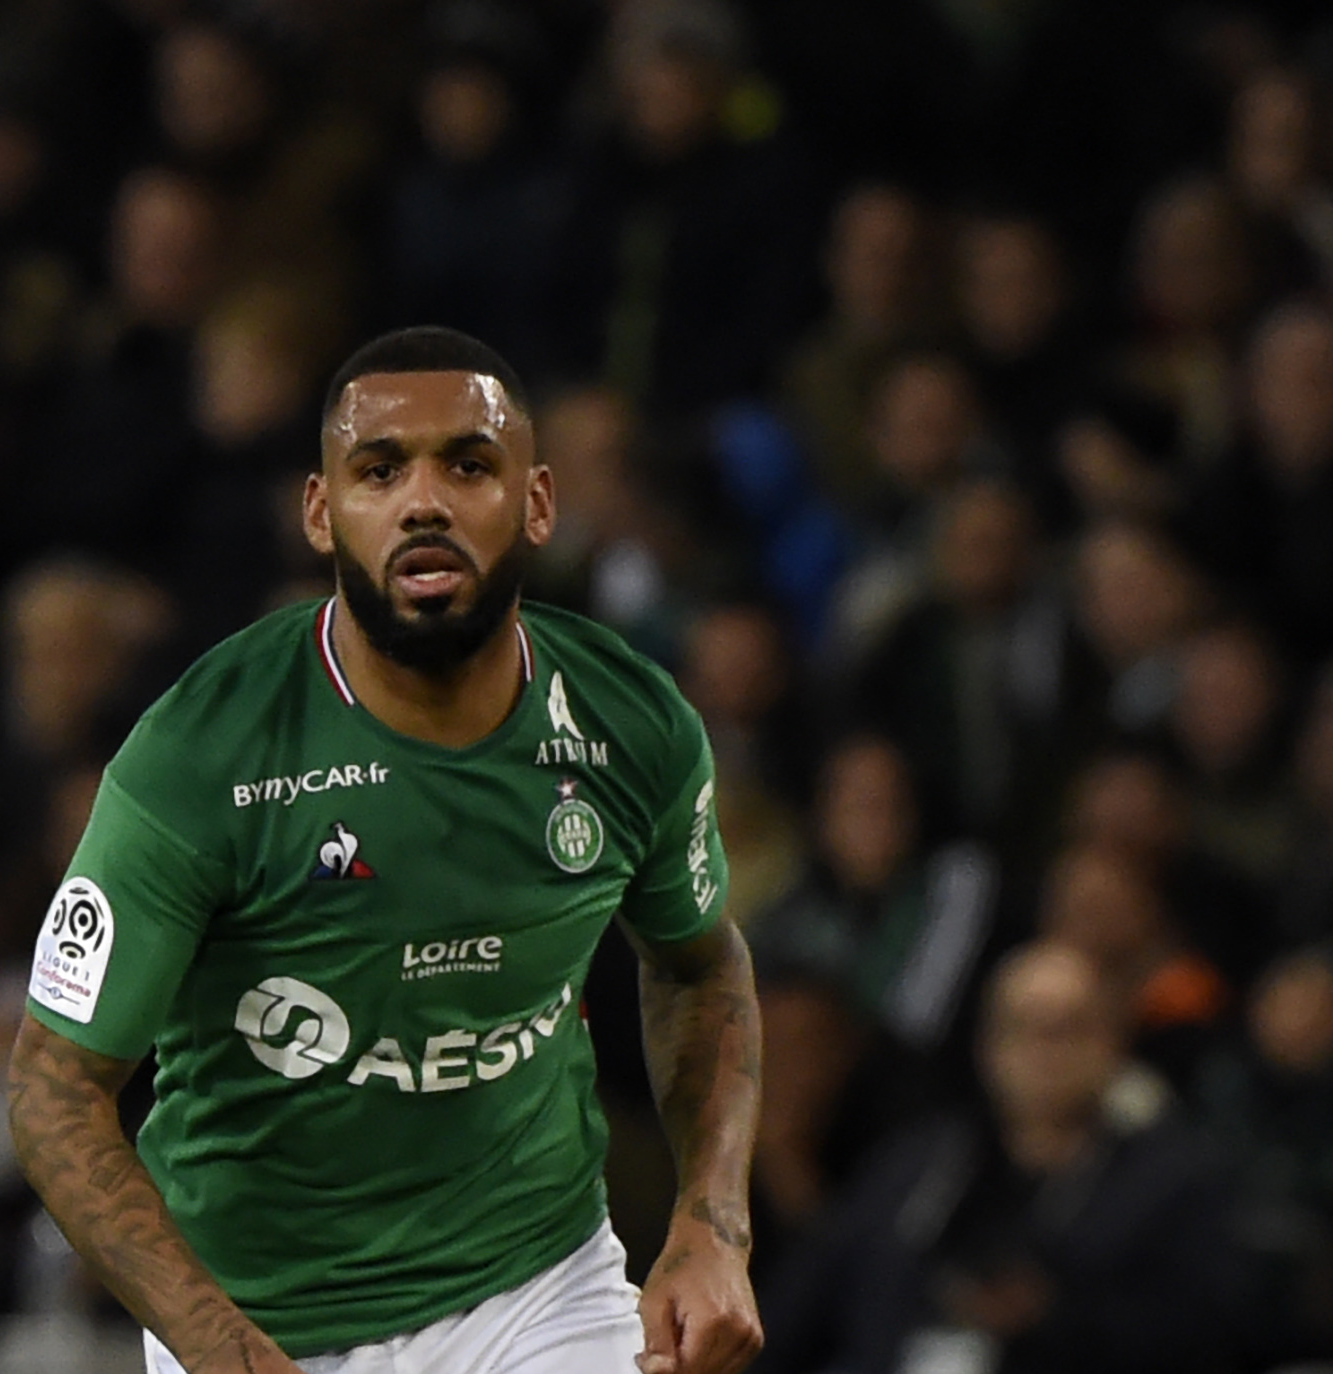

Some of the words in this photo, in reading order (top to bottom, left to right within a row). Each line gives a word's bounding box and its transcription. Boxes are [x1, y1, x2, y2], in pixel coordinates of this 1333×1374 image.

[535, 737, 609, 767] ATRUM
[36, 960, 92, 998] Conforama
[42, 951, 78, 977] LIGUE
